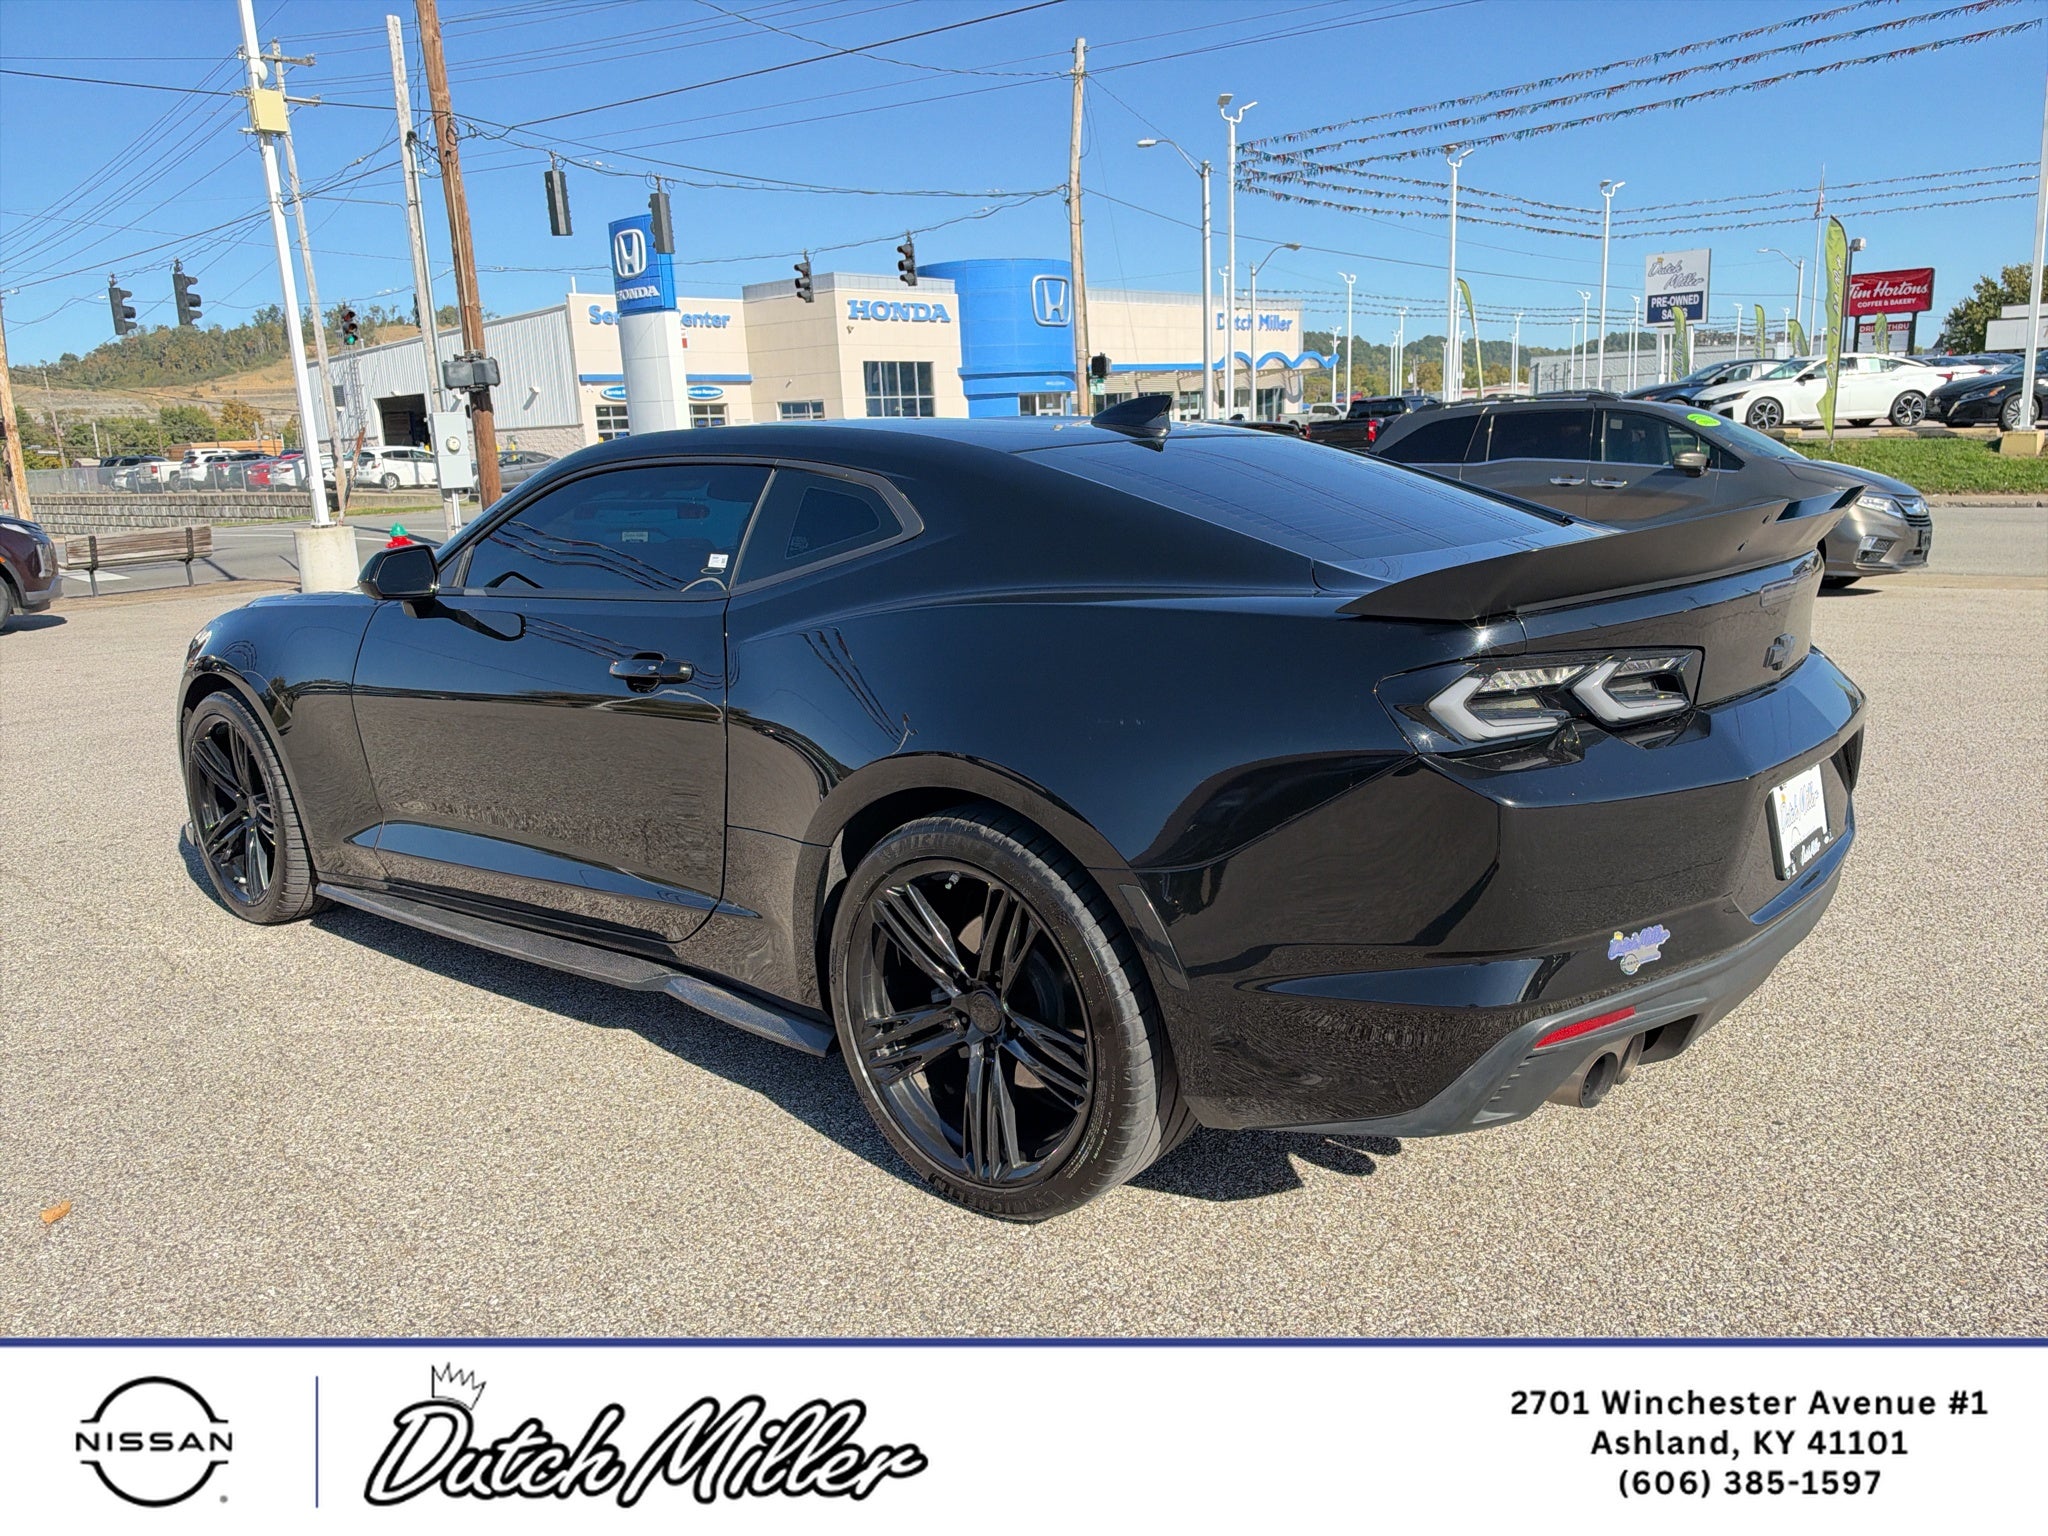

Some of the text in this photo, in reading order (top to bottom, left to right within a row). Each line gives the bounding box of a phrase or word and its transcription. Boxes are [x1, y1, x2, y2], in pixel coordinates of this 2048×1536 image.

[1648, 259, 1683, 278] Dutch
[1663, 272, 1704, 290] Miller
[1849, 280, 1929, 300] Tim Hortons
[1651, 294, 1700, 308] PRE-OWNED
[1857, 300, 1882, 308] COFFEE
[1890, 298, 1917, 306] BAKERY
[679, 310, 731, 329] enter
[847, 299, 951, 323] HONDA
[1661, 307, 1688, 320] SAS
[1258, 313, 1293, 331] Miller
[1887, 322, 1910, 331] THRU
